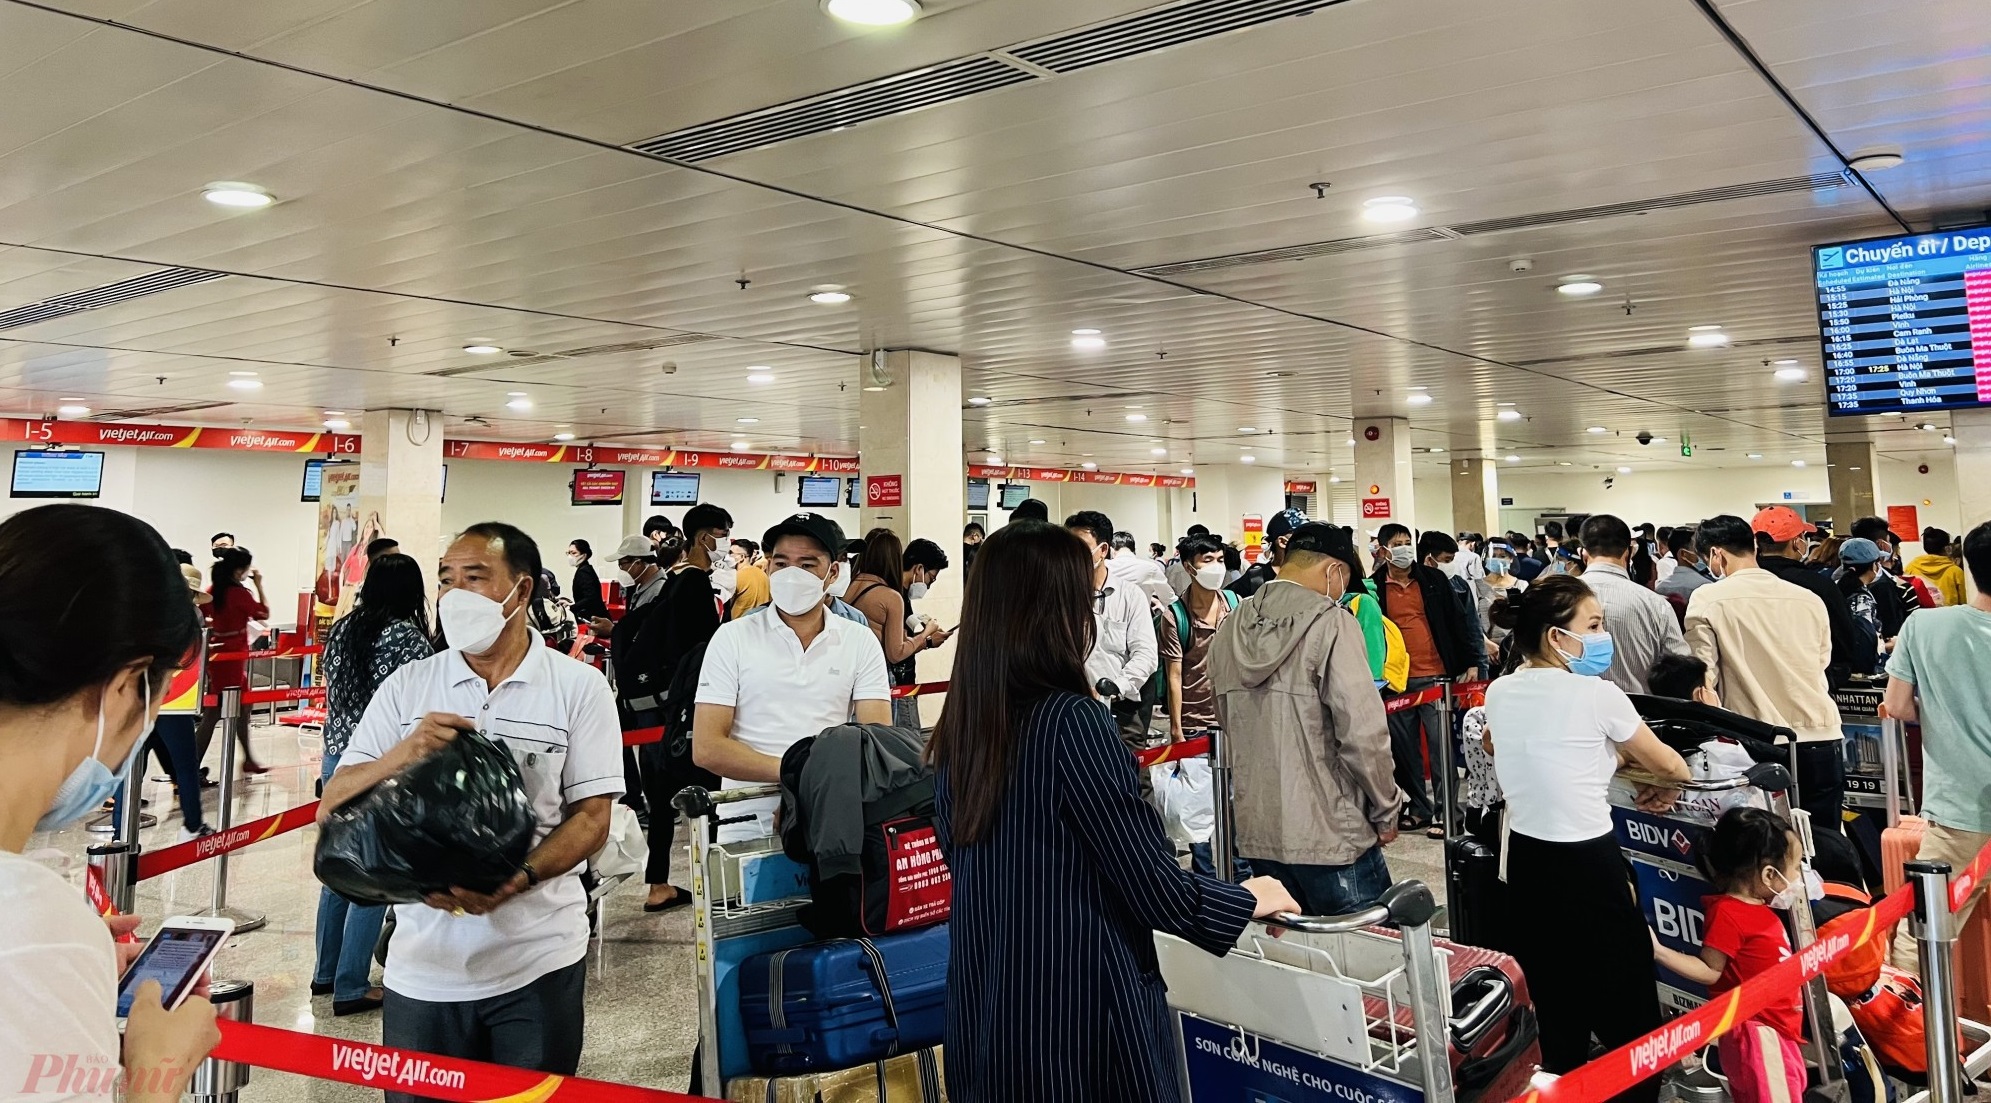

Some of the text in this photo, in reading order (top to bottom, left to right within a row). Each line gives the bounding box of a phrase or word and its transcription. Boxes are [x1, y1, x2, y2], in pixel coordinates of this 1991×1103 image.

[1846, 242, 1914, 264] Chuyến
[1825, 286, 1846, 294] 14:55
[1826, 294, 1847, 302] 15:15
[1828, 302, 1848, 310] 15:25
[1828, 310, 1848, 318] 15:30
[1829, 318, 1850, 326] 15:50
[1834, 365, 1890, 376] 17:00 17:25
[1836, 376, 1856, 384] 17:20
[1899, 380, 1916, 388] Vinh
[1836, 384, 1858, 392] 17:20
[1900, 396, 1925, 404] Thanh
[1846, 780, 1876, 790] 19 19
[1626, 818, 1668, 848] BIDV
[896, 857, 908, 871] AN
[910, 850, 932, 868] HỒNG
[1195, 1036, 1222, 1057] SƠN
[1262, 1060, 1300, 1086] NGHỆ
[1302, 1072, 1332, 1093] CHO
